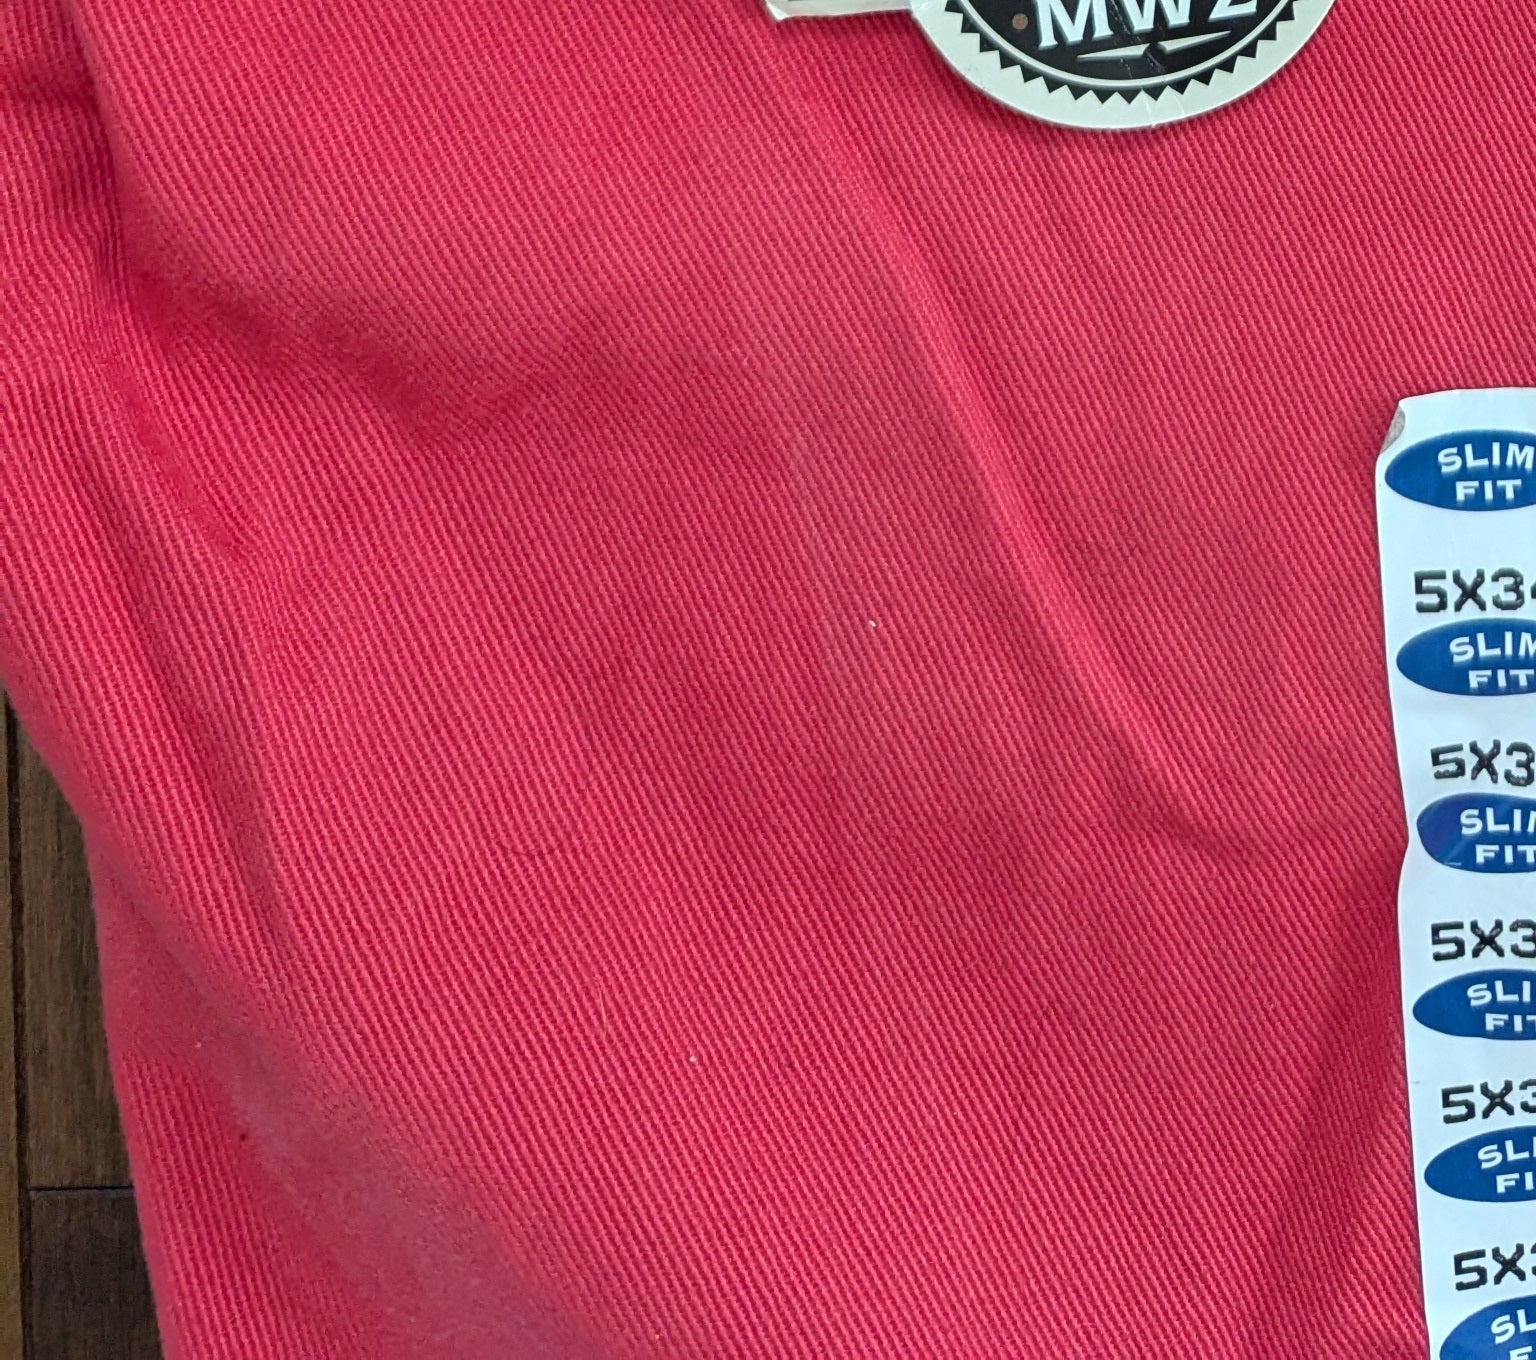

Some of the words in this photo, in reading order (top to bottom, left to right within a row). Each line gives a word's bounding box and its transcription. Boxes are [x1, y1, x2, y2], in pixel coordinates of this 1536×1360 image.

[1437, 442, 1535, 473] SLIM
[1455, 479, 1523, 503] FIT
[1468, 668, 1535, 691] FIT
